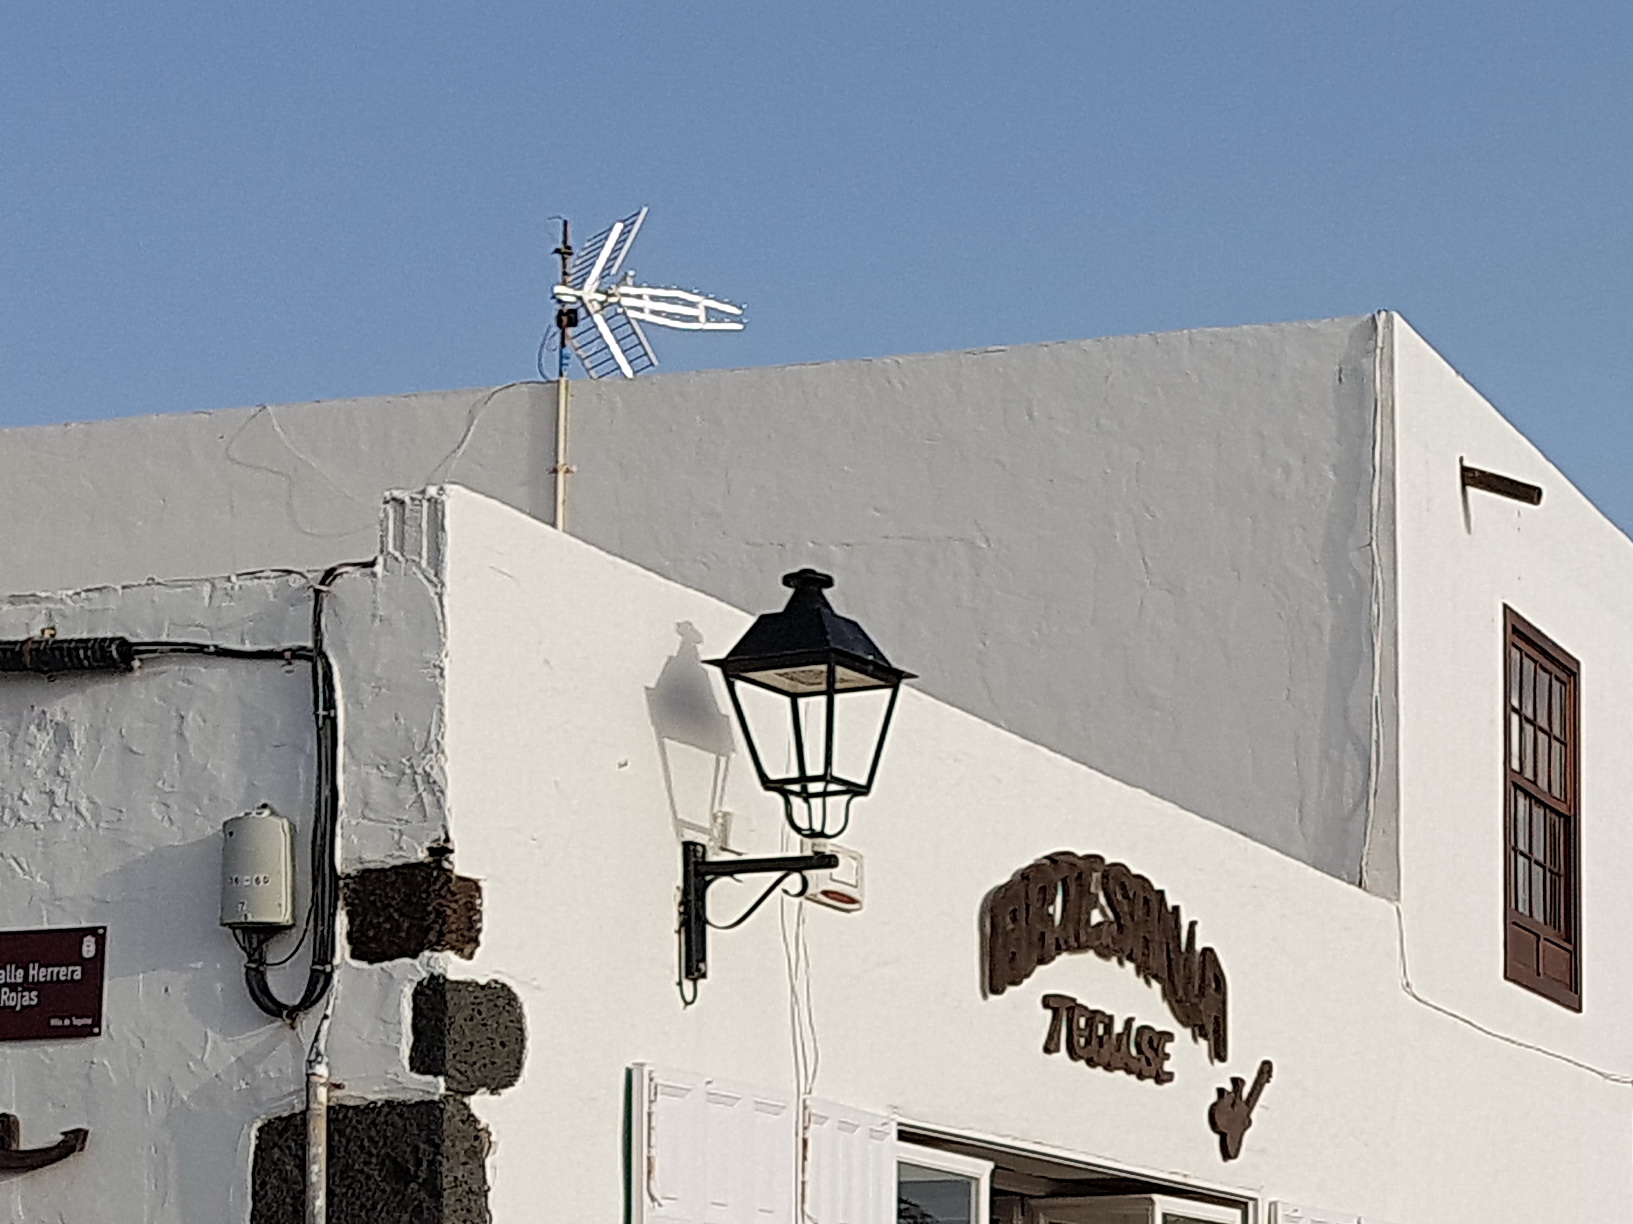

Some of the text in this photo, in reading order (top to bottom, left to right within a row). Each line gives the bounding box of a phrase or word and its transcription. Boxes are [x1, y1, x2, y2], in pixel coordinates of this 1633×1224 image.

[28, 962, 82, 983] Herrera
[0, 986, 38, 1012] Rojas
[1041, 993, 1176, 1085] TEGUISE
